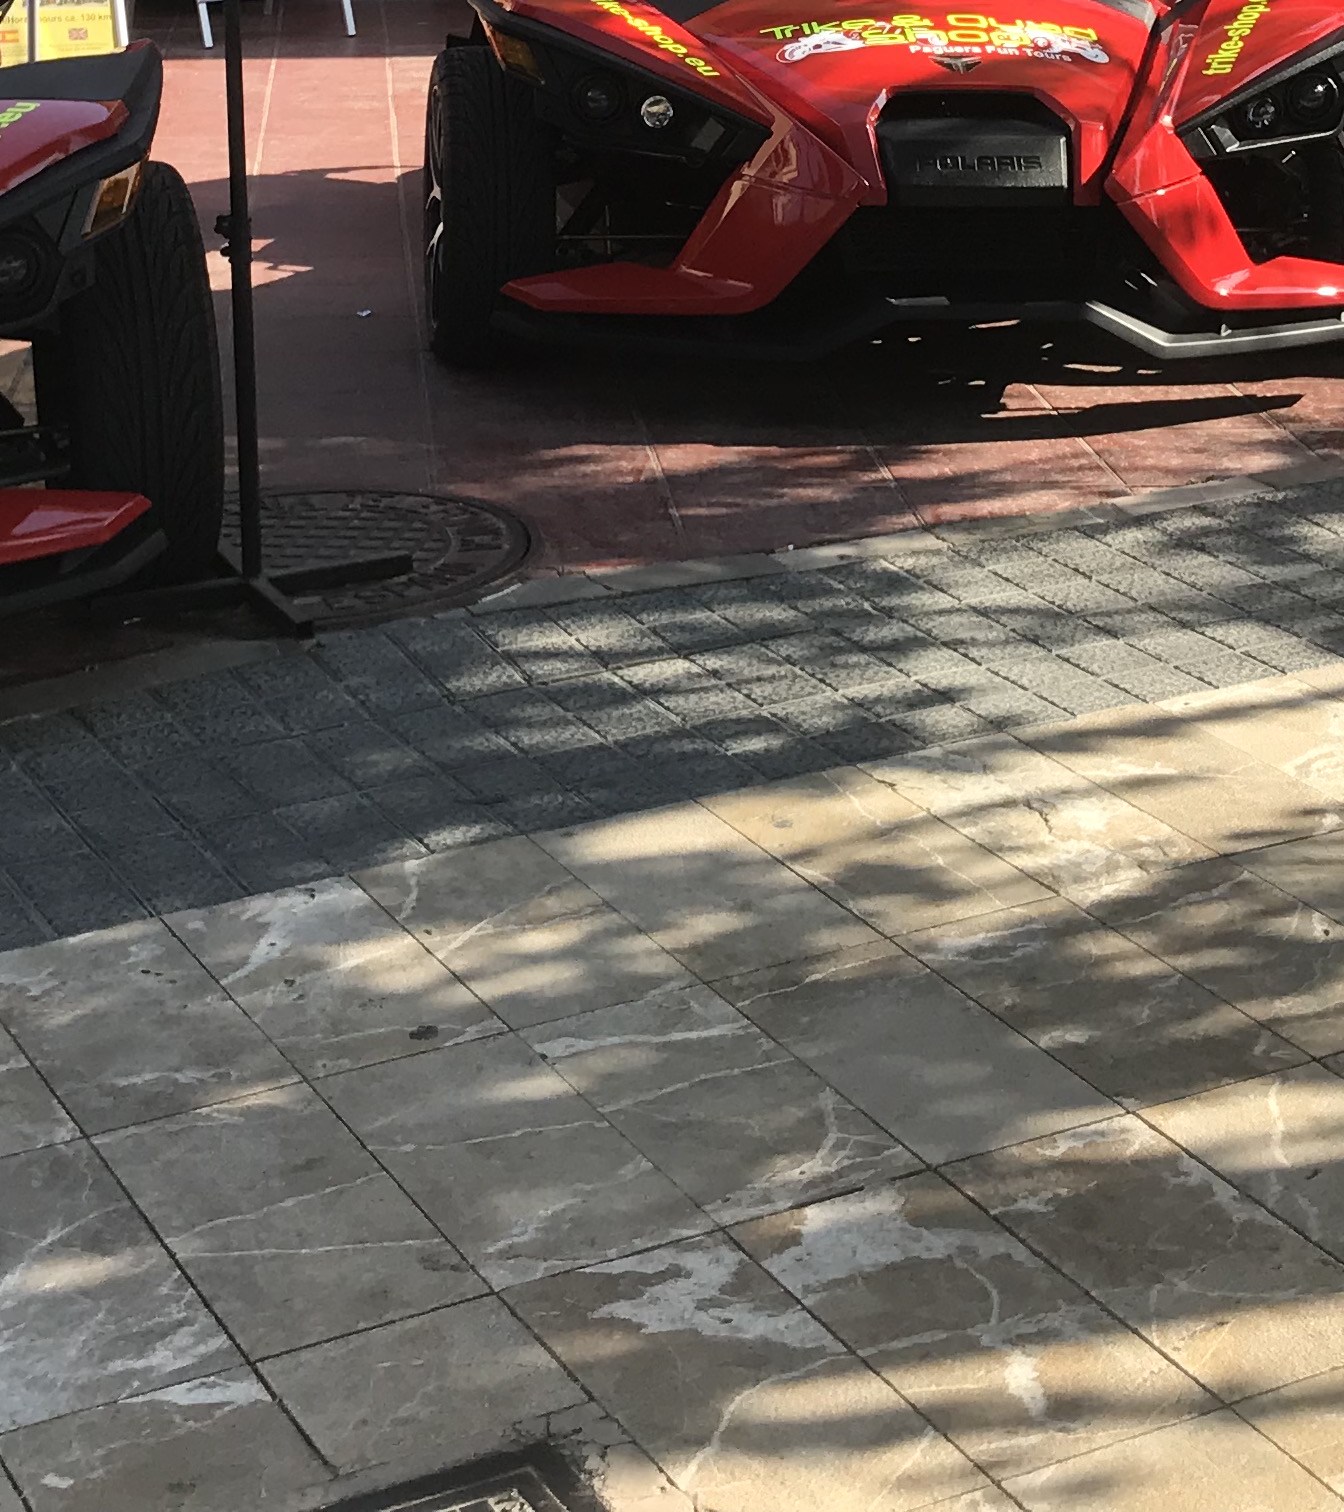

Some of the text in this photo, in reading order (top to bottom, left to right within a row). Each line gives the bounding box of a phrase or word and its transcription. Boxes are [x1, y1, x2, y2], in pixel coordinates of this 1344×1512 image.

[39, 14, 63, 24] ours
[80, 13, 97, 22] 130
[97, 13, 113, 22] km
[759, 13, 1099, 42] Trike & Quad
[861, 26, 1034, 48] Shop
[908, 43, 1073, 63] Paguera Fun Tours
[915, 154, 1043, 174] POLARIS
